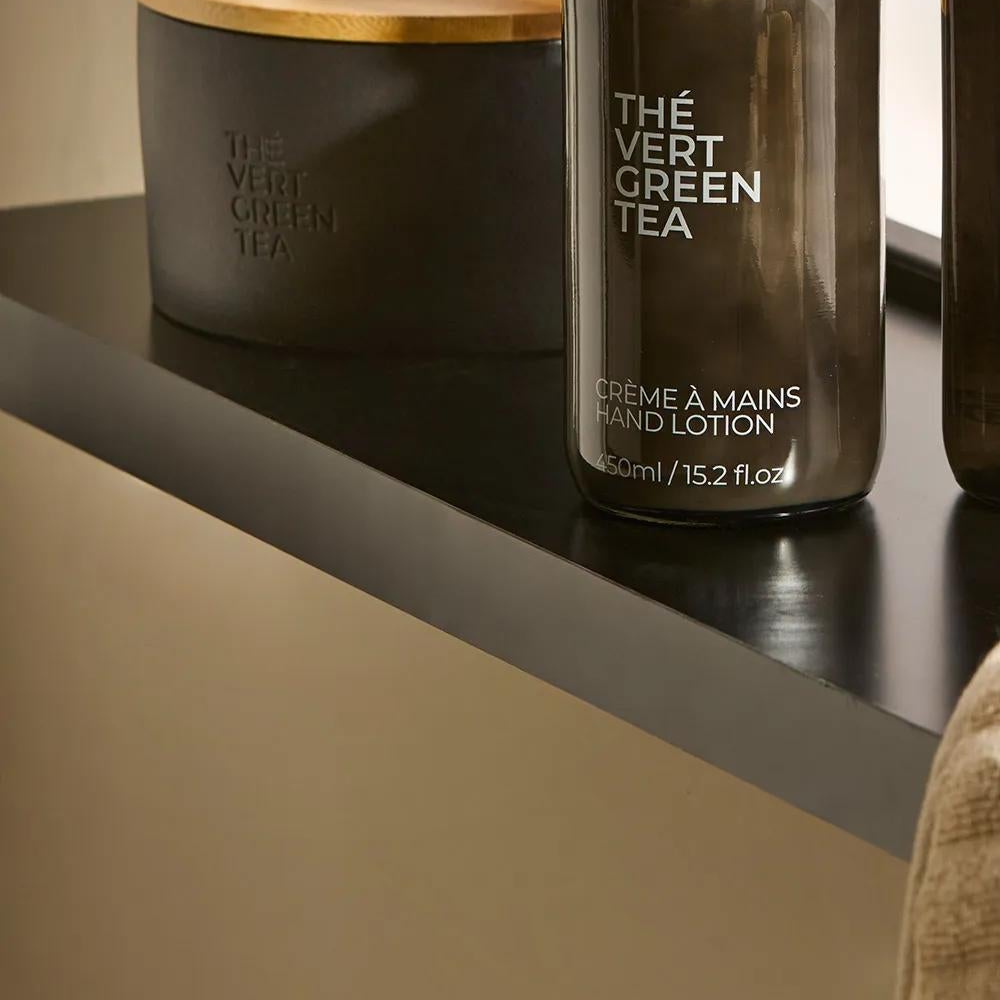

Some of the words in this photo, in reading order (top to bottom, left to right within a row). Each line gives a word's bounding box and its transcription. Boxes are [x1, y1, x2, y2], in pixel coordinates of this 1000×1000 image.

[614, 89, 695, 131] THÉ
[614, 127, 724, 167] VERT
[614, 165, 761, 203] GREEN
[614, 199, 694, 239] TEA
[595, 378, 678, 410] CRÈME
[684, 385, 705, 411] À
[712, 386, 801, 411] MAINS
[595, 402, 664, 433] HAND
[671, 412, 775, 436] LOTION
[596, 452, 662, 483] 450ml
[667, 460, 679, 486] /
[682, 464, 728, 486] 15.2
[733, 463, 784, 486] fl.oz
